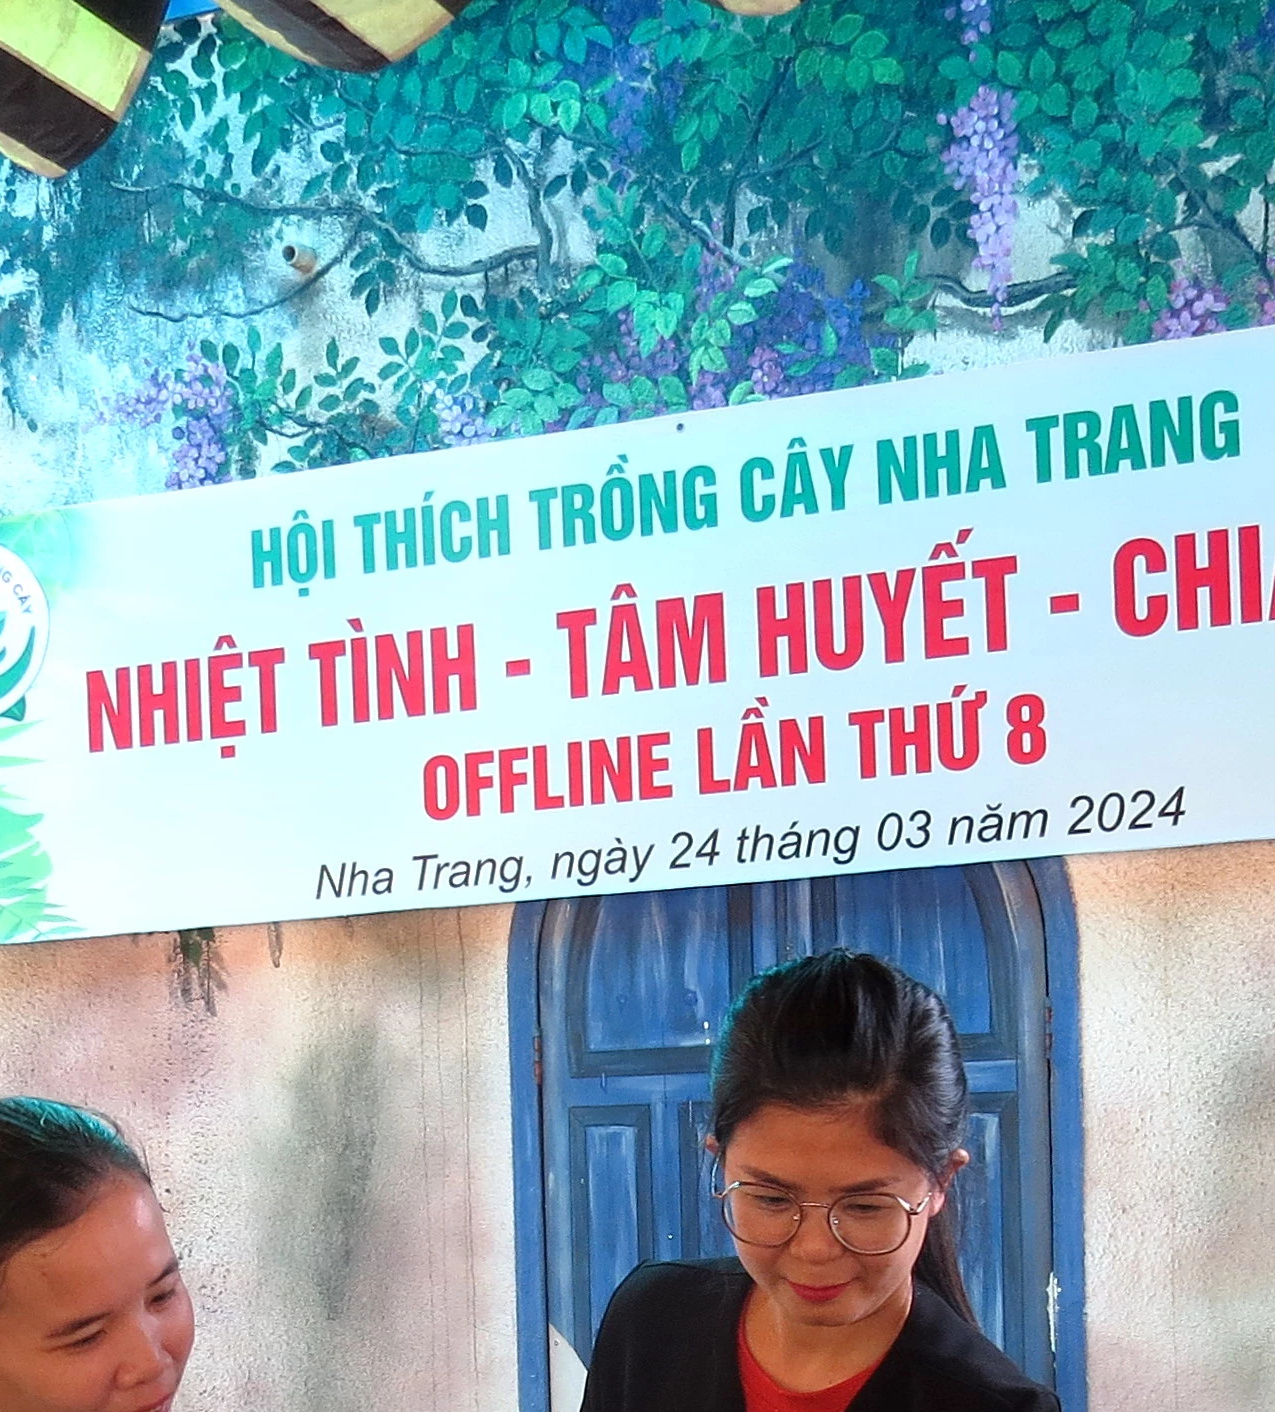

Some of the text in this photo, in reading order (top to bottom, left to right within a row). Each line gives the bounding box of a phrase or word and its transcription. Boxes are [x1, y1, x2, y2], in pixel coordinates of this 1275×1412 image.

[252, 389, 1241, 597] HỘI THÍCH TRỒNG CÂY NHA TRANG
[87, 635, 285, 759] NHIỆT
[309, 618, 477, 726] TÌNH
[506, 660, 530, 676] -
[557, 584, 727, 698] TÂM
[757, 529, 1018, 678] HUYẾT
[1050, 594, 1079, 613] -
[424, 684, 1047, 820] OFFLINE LẦN THỨ 8
[316, 786, 1186, 900] Nha Trang, ngày 24 tháng 03 năm 2024
